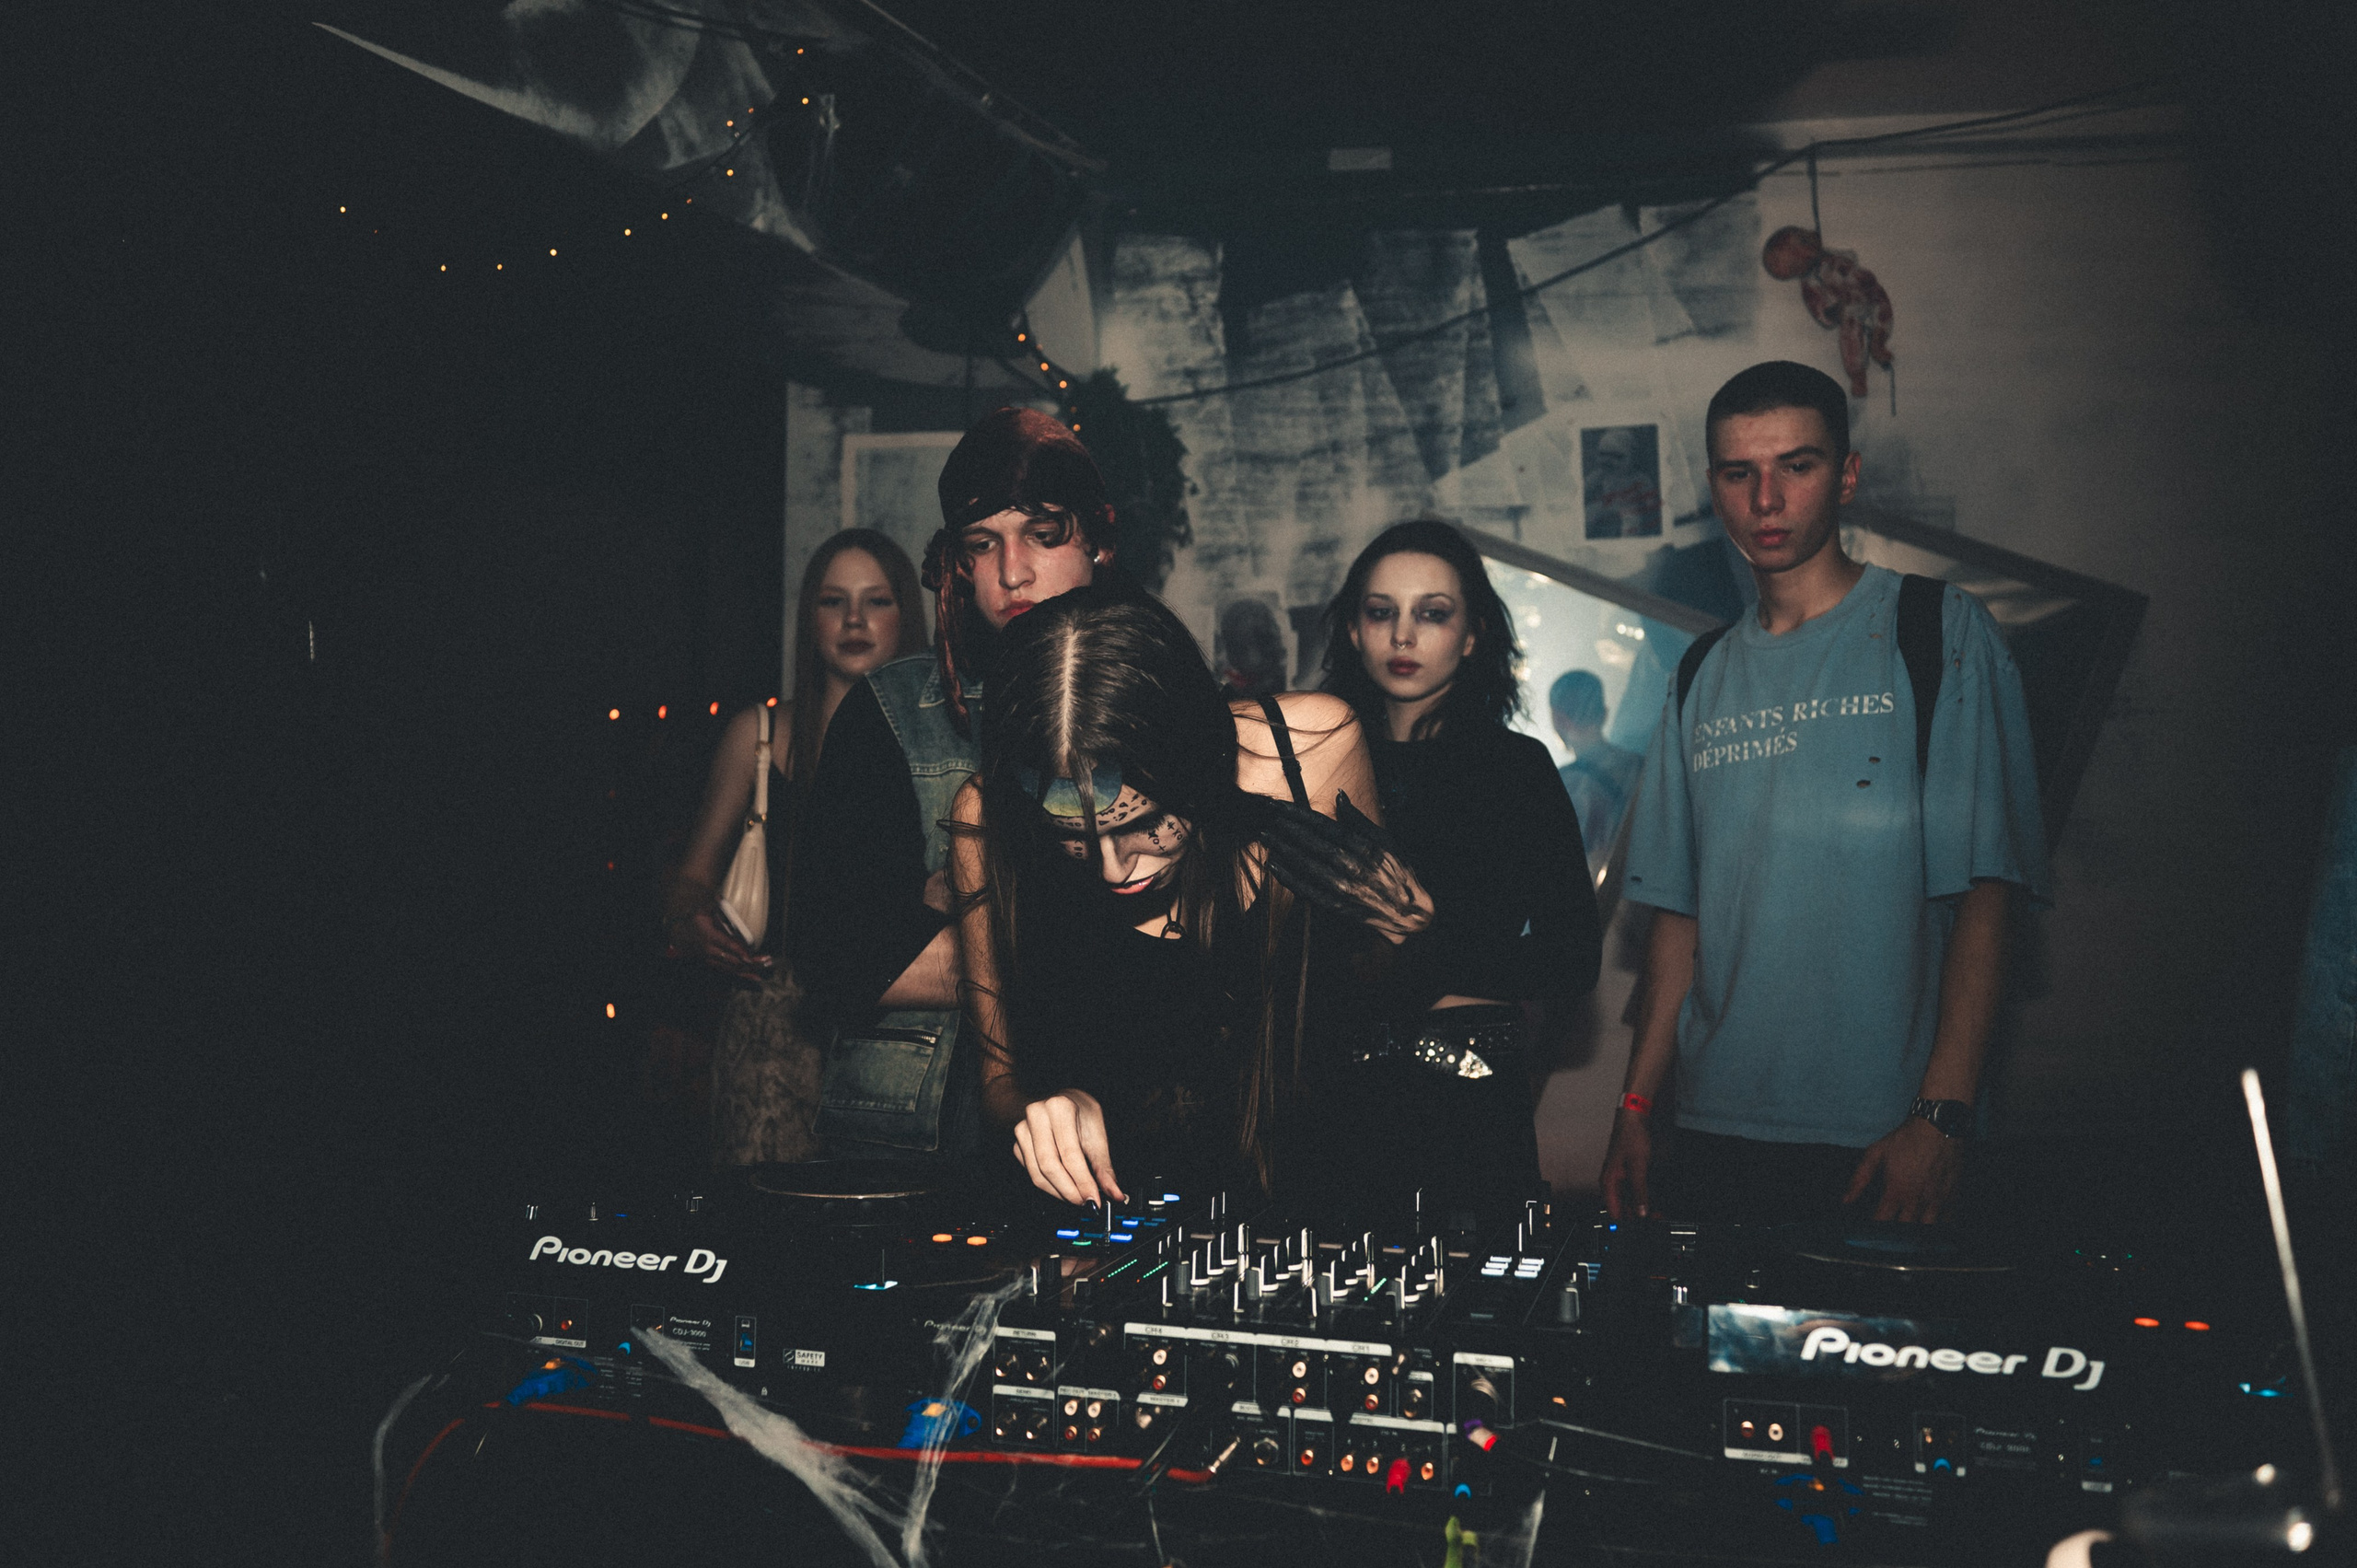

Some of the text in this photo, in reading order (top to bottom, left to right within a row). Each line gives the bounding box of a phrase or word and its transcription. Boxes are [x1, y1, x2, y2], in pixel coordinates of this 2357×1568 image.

[1693, 691, 1895, 744] ENFANTS RICHES
[1693, 727, 1798, 772] DÉPRIMÉS
[528, 1235, 678, 1272] Pioneer
[669, 1315, 702, 1326] Pioneer
[923, 1319, 971, 1331] Pioneer
[796, 1351, 822, 1360] SAFETY
[1799, 1326, 2029, 1377] Pioneer
